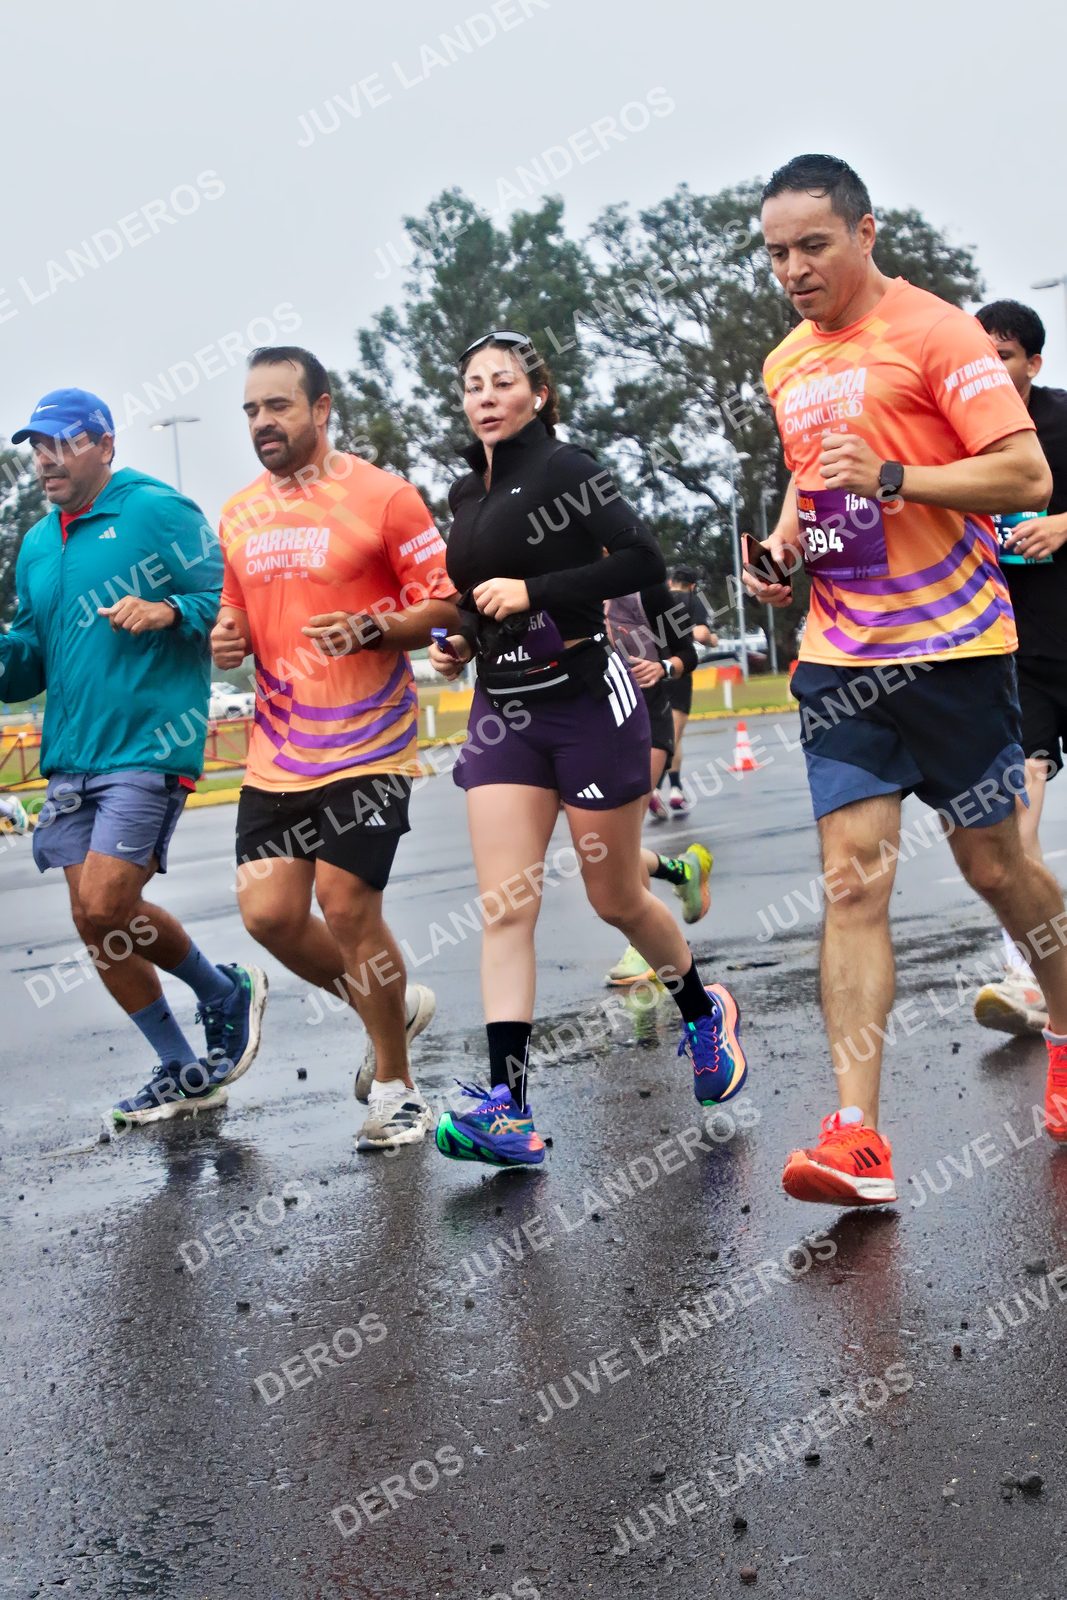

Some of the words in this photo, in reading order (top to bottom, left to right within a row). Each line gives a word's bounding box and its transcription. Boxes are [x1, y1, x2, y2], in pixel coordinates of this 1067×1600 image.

[784, 367, 867, 415] CARRERA
[784, 402, 845, 434] OMNILIFE
[245, 526, 331, 558] CARRERA
[246, 552, 308, 577] OMNILIFE
